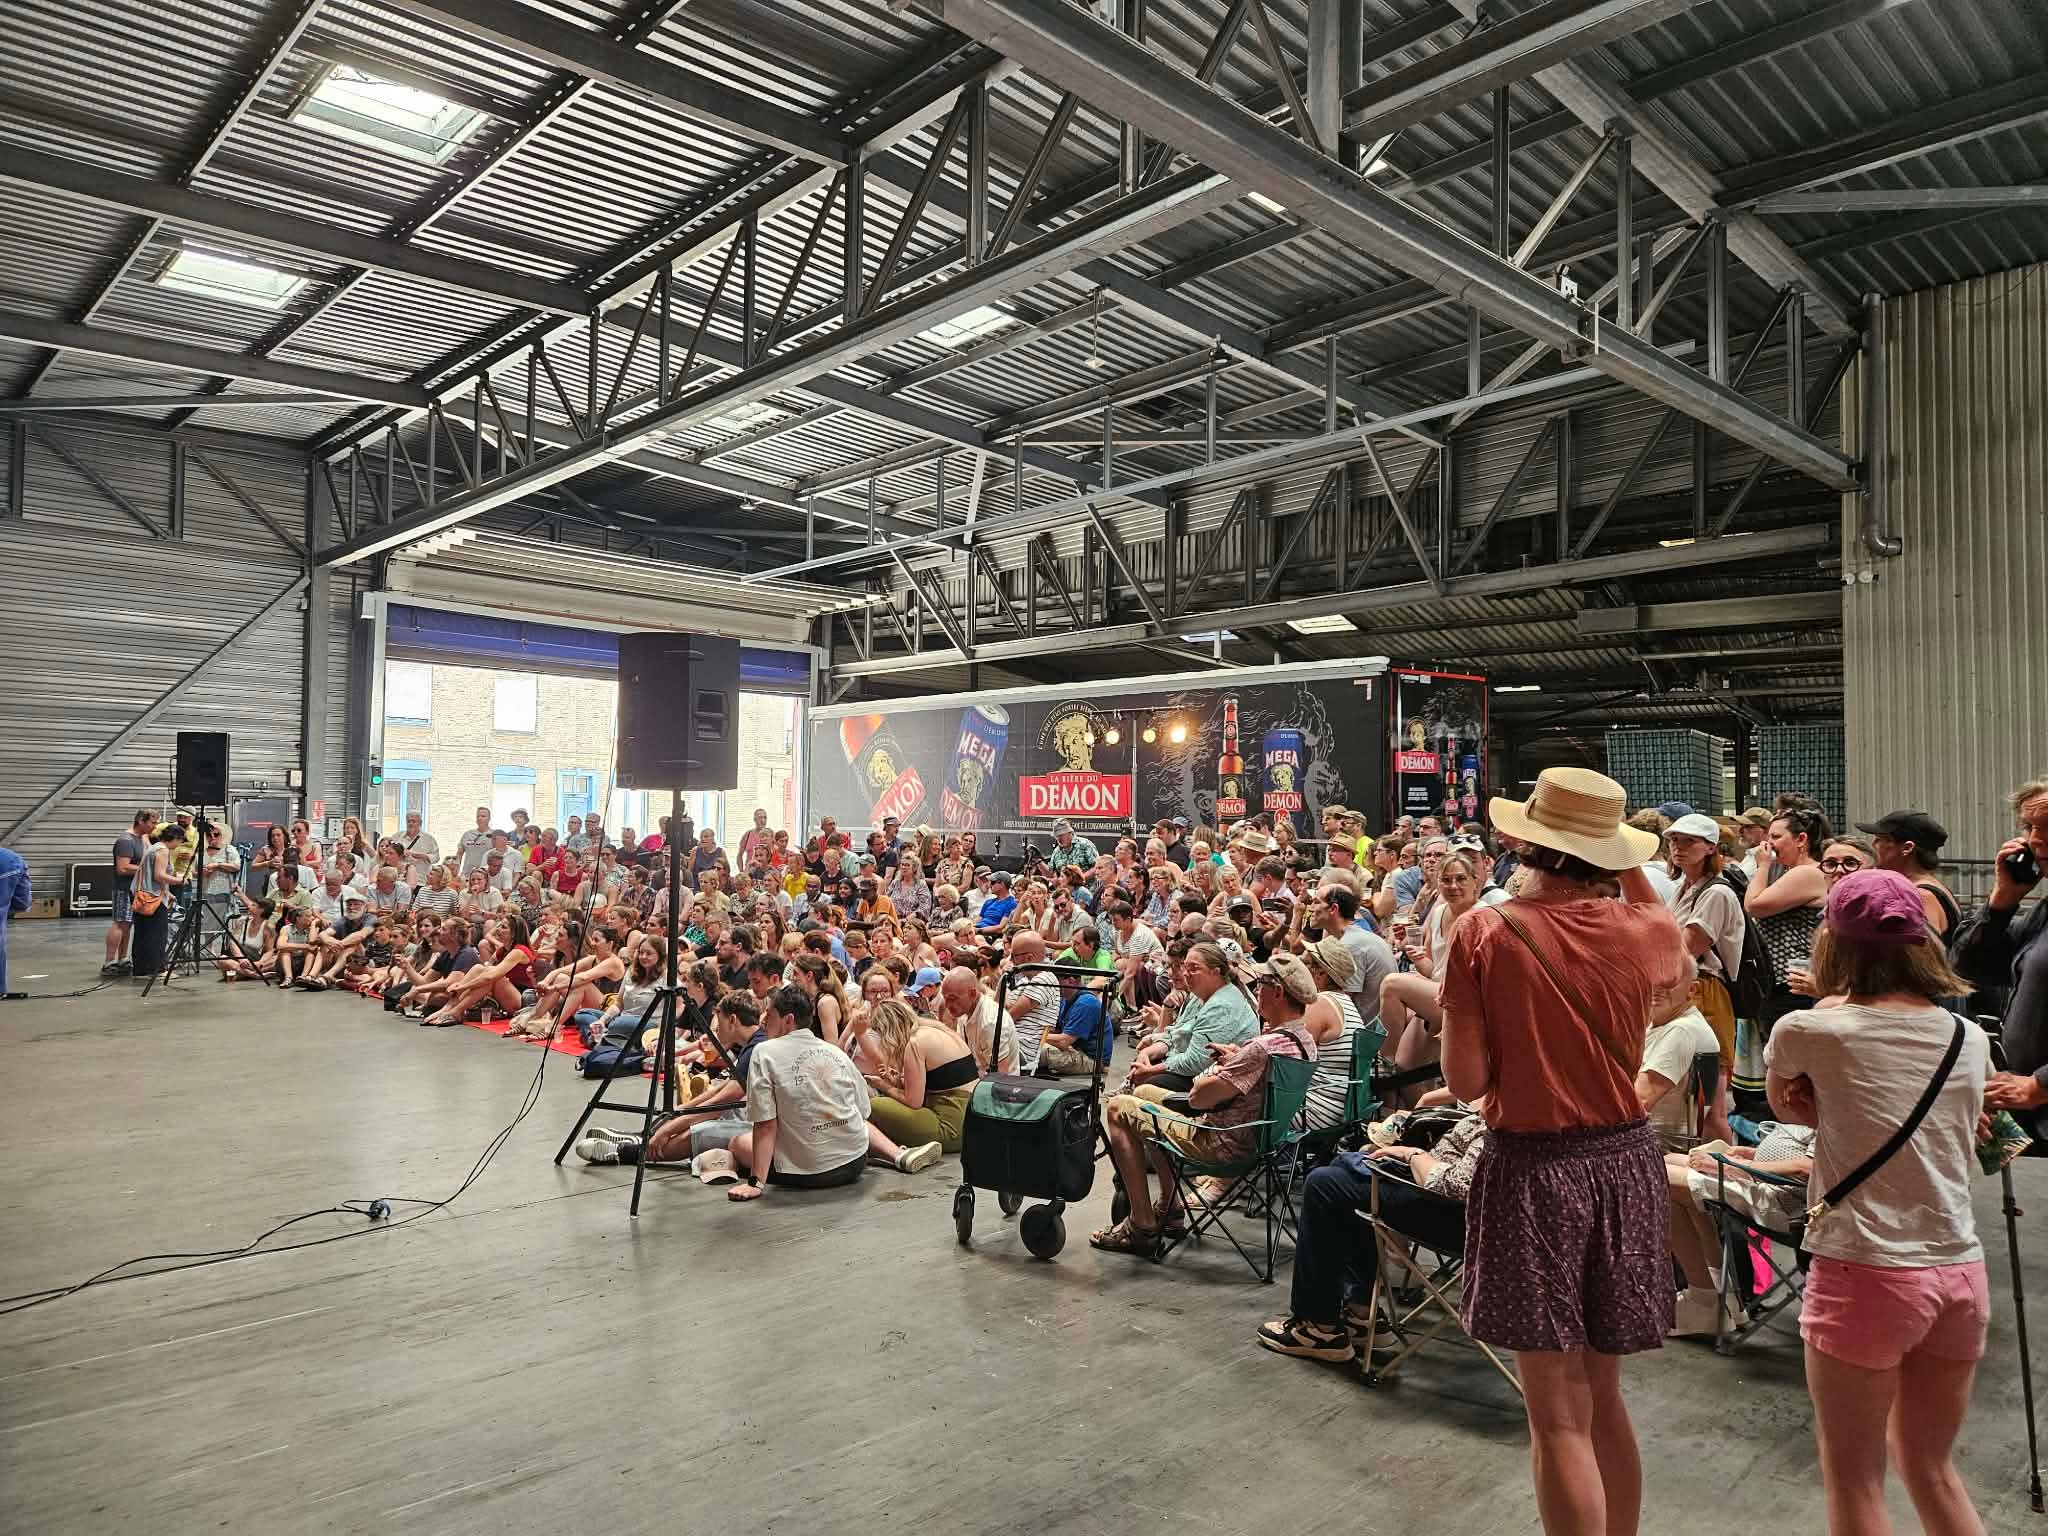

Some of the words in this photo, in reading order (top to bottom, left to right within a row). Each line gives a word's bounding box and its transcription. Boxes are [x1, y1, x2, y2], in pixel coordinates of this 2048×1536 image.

[958, 731, 996, 776] MEGA
[1265, 750, 1300, 768] MEGA
[1400, 755, 1435, 770] DEMON
[1050, 775, 1060, 783] LA
[1030, 784, 1120, 811] DEMON
[1264, 793, 1302, 809] DEMON
[811, 1120, 849, 1134] CALIFORNIA
